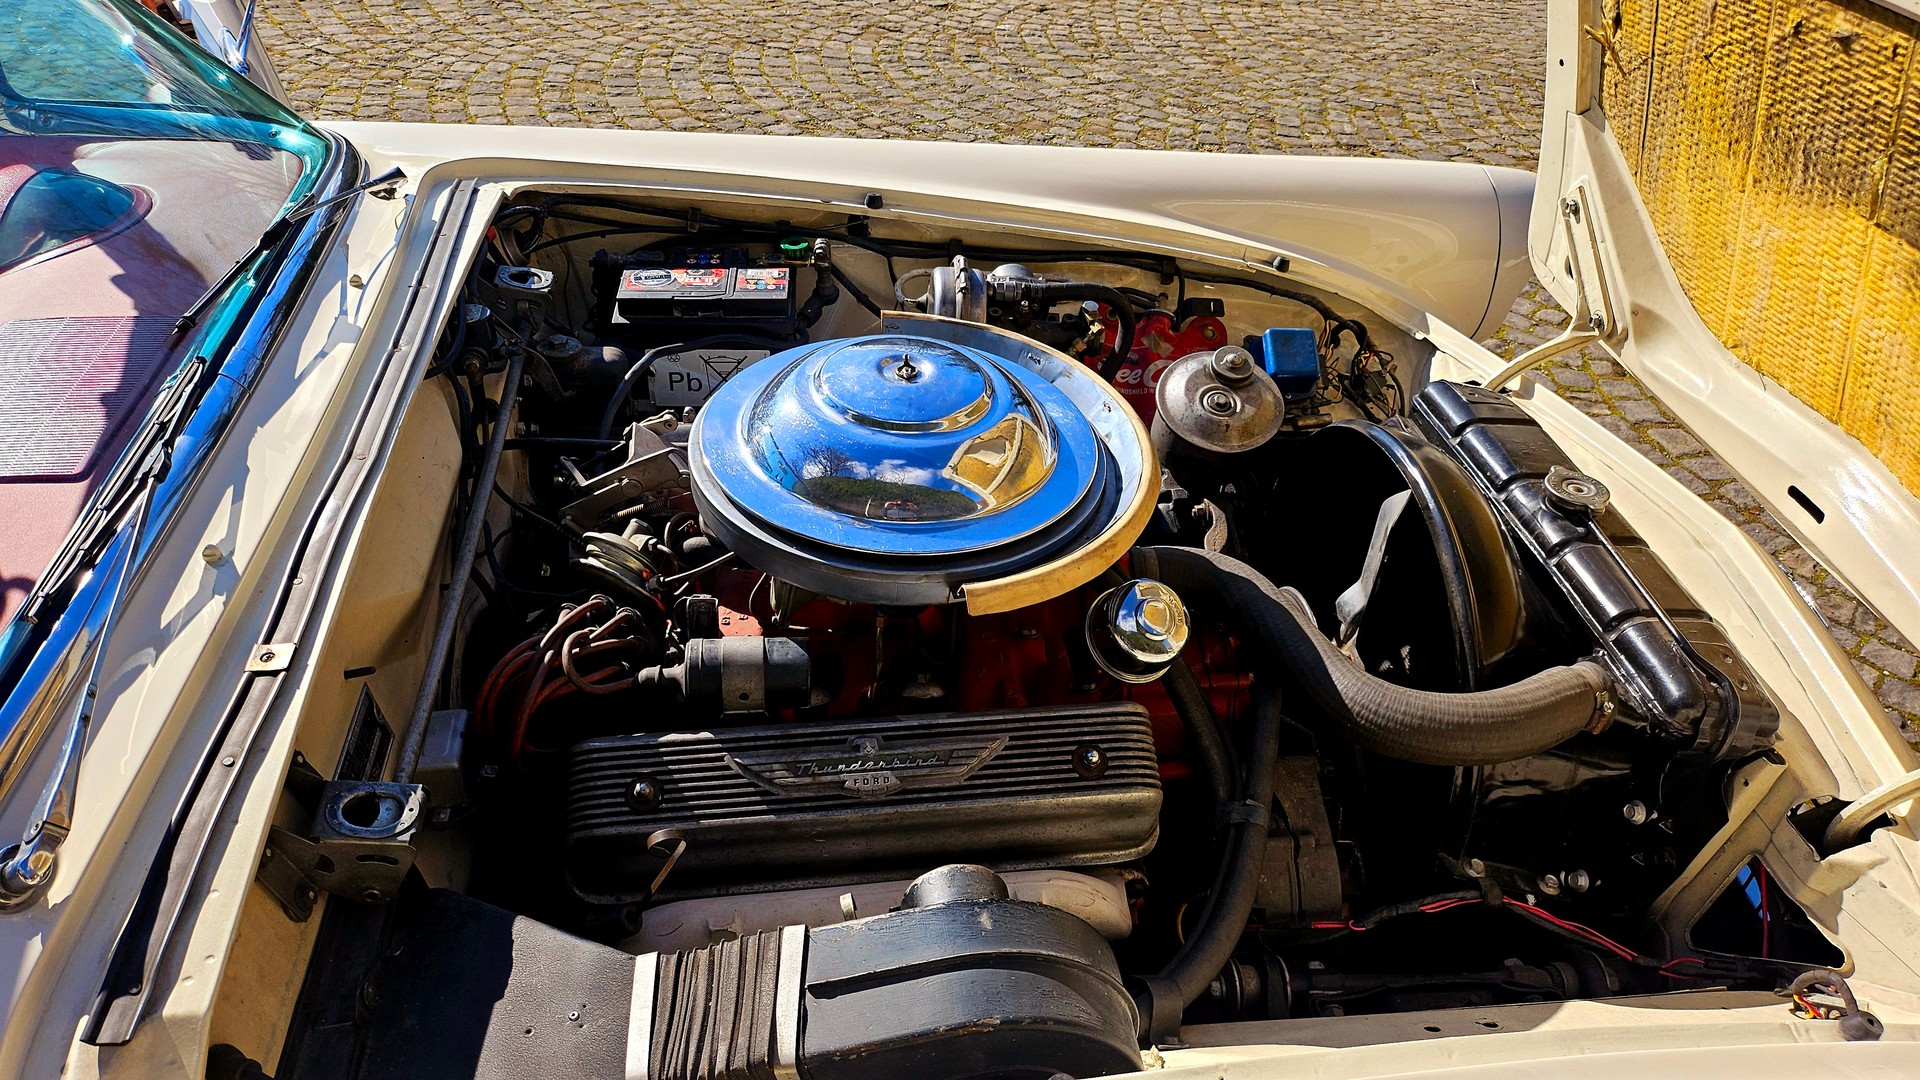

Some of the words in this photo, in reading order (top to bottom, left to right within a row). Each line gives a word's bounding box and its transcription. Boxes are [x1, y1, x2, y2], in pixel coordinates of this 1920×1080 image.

[668, 371, 703, 392] Pb
[1119, 387, 1148, 395] NDSHIELD
[796, 755, 945, 775] Thunderbird
[853, 776, 890, 787] FORD
